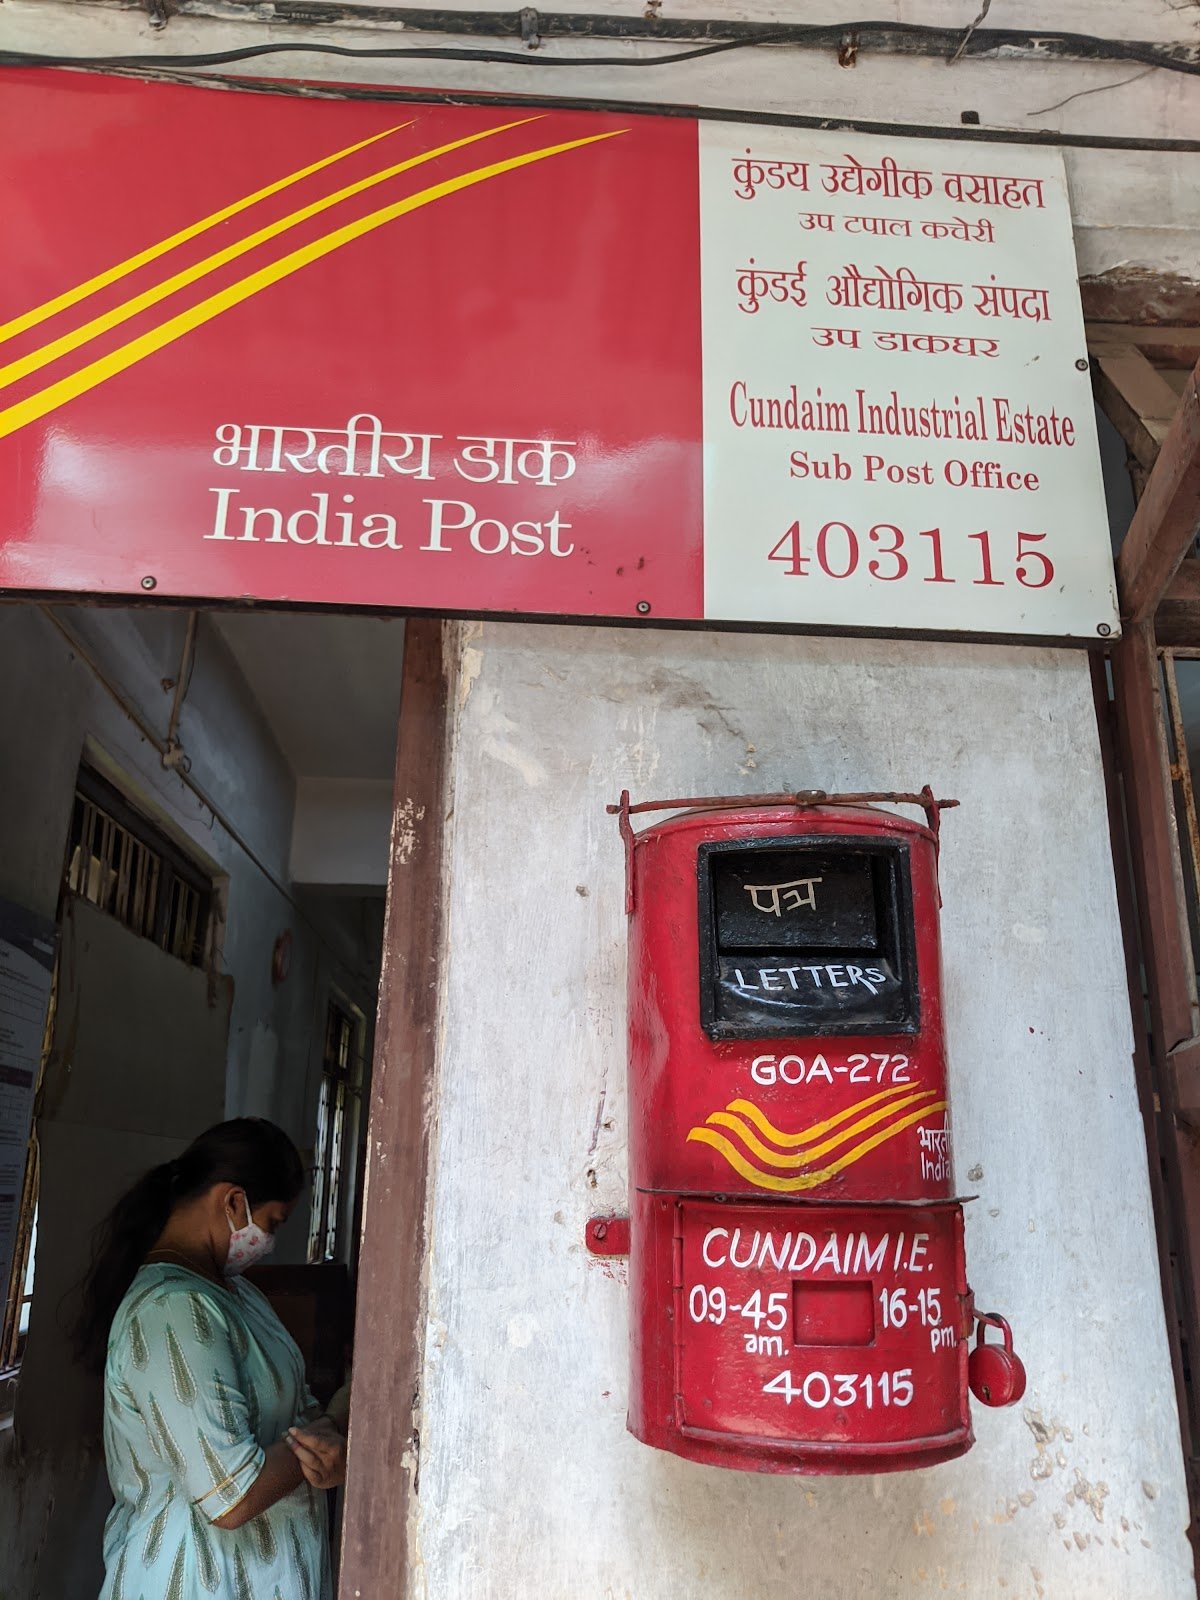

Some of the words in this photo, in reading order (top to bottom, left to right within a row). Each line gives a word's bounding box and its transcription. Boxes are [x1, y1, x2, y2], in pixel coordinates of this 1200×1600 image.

[942, 173, 1046, 209] वसाहत
[799, 212, 834, 232] उप
[844, 215, 911, 237] टपाल
[920, 216, 995, 243] कचेरी
[736, 258, 808, 313] कुंडई
[826, 264, 963, 313] औद्योगिक
[972, 275, 1052, 321] संपदा
[811, 327, 861, 349] उप
[873, 331, 1000, 357] डाकघर
[730, 381, 850, 432] Cundaim
[856, 389, 988, 441] Industrial
[993, 398, 1076, 447] Estate
[212, 413, 444, 481] भारतीय
[453, 436, 577, 487] डाक
[790, 451, 852, 481] Sub
[863, 455, 935, 485] Post
[944, 460, 1040, 491] Office
[203, 487, 404, 551] India
[419, 498, 575, 558] Post
[767, 520, 1055, 588] 403115
[743, 877, 823, 917] पत्र
[734, 964, 887, 996] LETTERS
[750, 1053, 911, 1086] GOA-272
[920, 1151, 951, 1182] India
[702, 1227, 889, 1274] CUNDAIM
[893, 1231, 934, 1272] I.E.
[689, 1284, 789, 1331] 09-45
[743, 1332, 790, 1357] am.
[879, 1287, 942, 1329] 16-15
[930, 1325, 957, 1354] pm.
[762, 1368, 914, 1409] 403115
